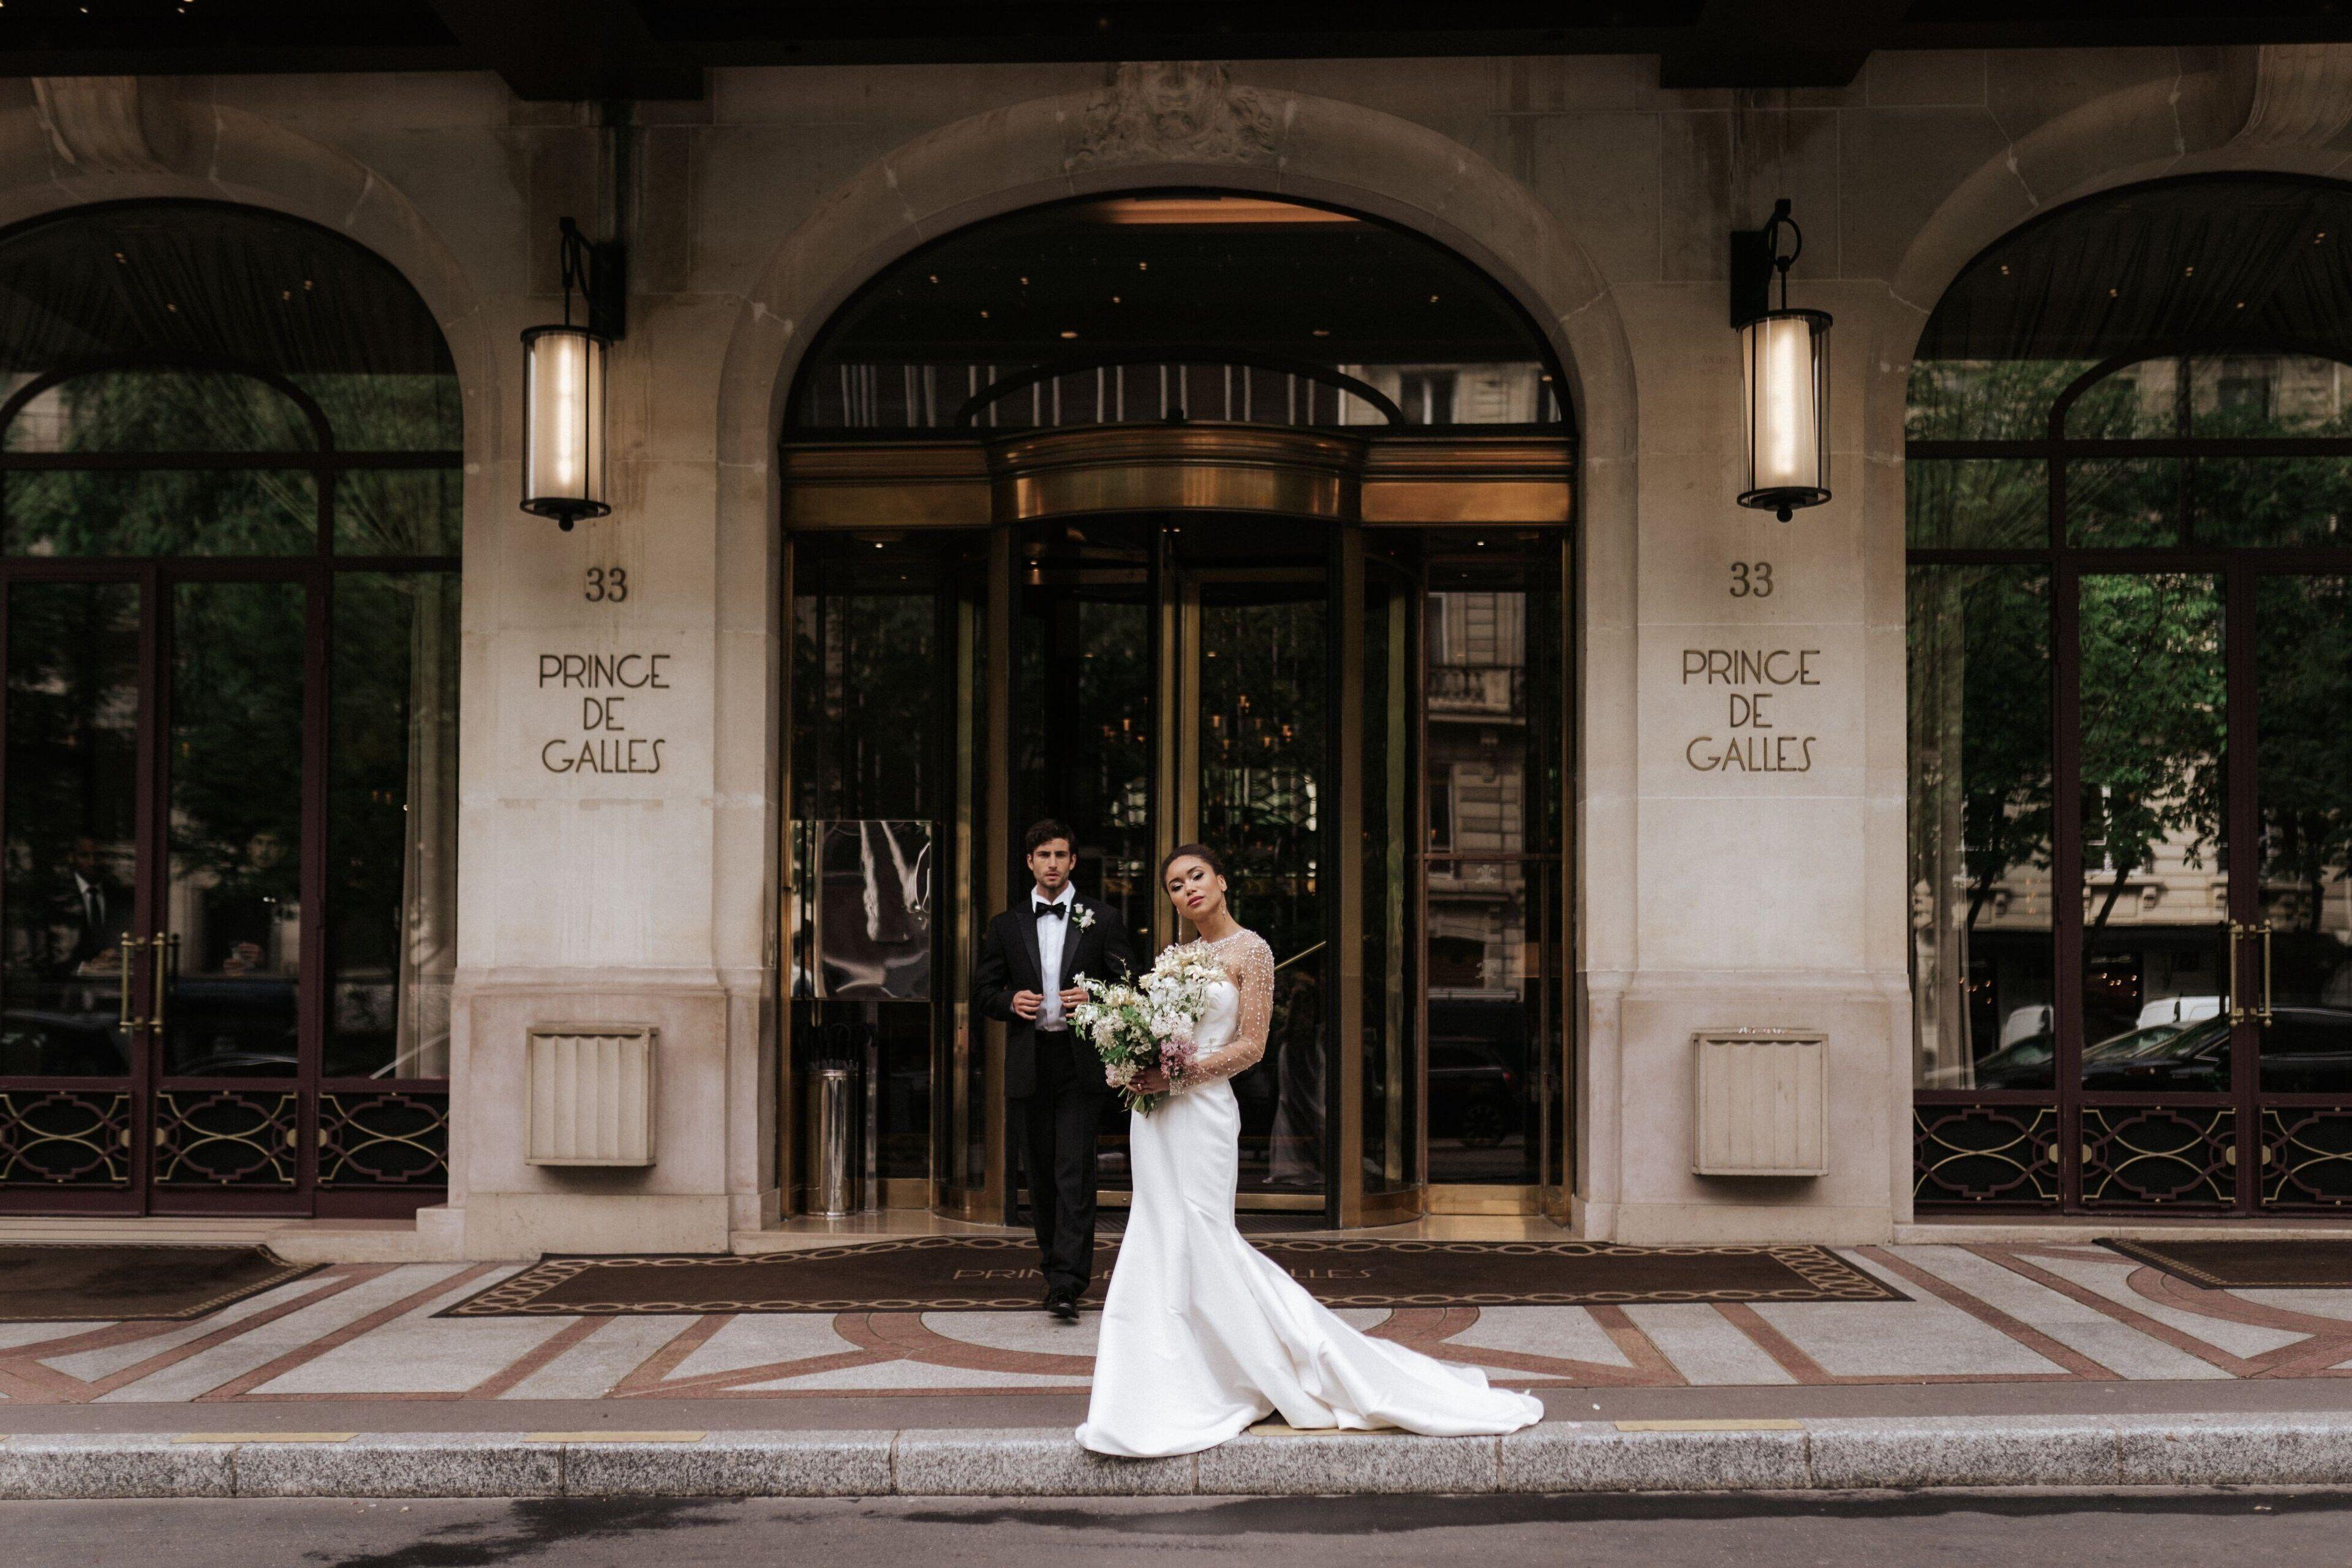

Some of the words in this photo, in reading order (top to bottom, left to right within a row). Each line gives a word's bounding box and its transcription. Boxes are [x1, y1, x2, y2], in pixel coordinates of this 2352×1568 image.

[586, 567, 627, 602] 33
[1730, 562, 1774, 598] 33
[540, 655, 670, 688] PRINCE
[1683, 650, 1820, 685] PRINCE
[583, 697, 625, 731] DE
[1730, 693, 1773, 728] DE
[542, 739, 665, 774] GALLES
[1686, 736, 1816, 772] GALLES
[1291, 1268, 1376, 1278] LLES
